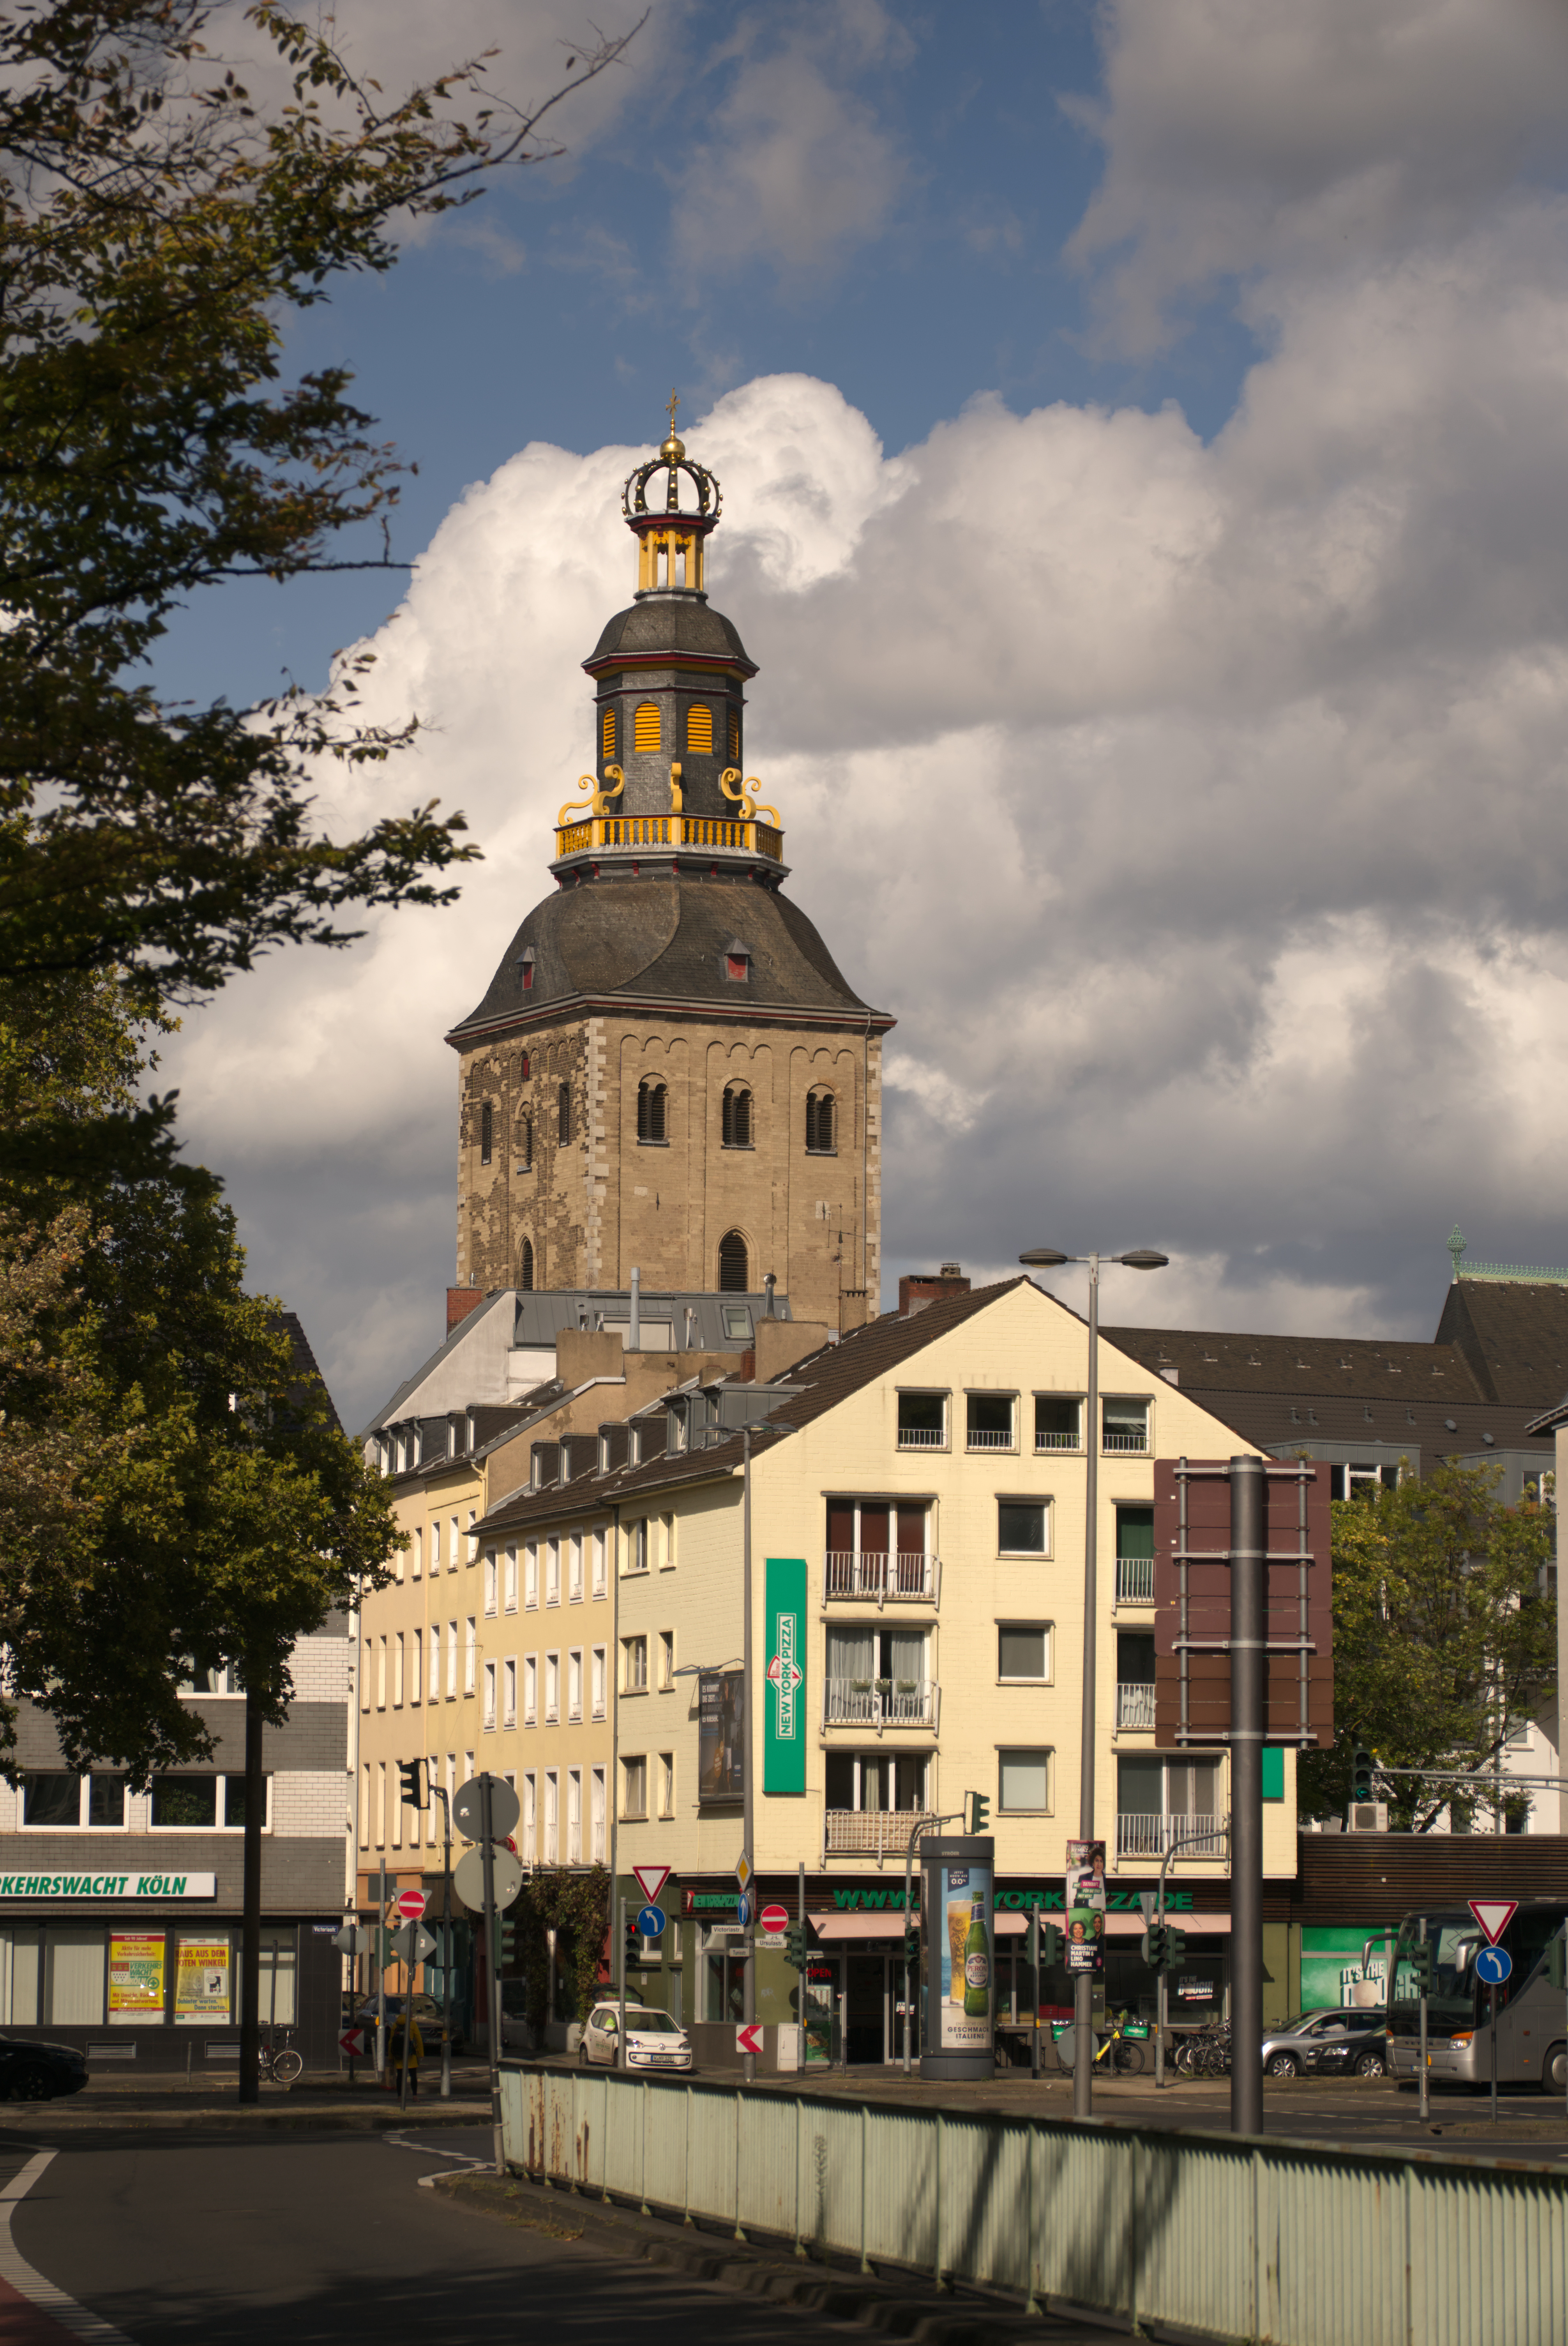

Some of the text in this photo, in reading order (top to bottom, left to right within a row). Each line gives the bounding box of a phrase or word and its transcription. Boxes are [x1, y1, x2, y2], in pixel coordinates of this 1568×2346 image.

[781, 1619, 791, 1734] NEW YORK PIZZA
[707, 1684, 719, 1692] KOMMT
[0, 1875, 187, 1895] KEHRSWACHT KÖLN
[807, 1968, 832, 1977] OPEN
[1343, 1966, 1363, 1983] IT'S
